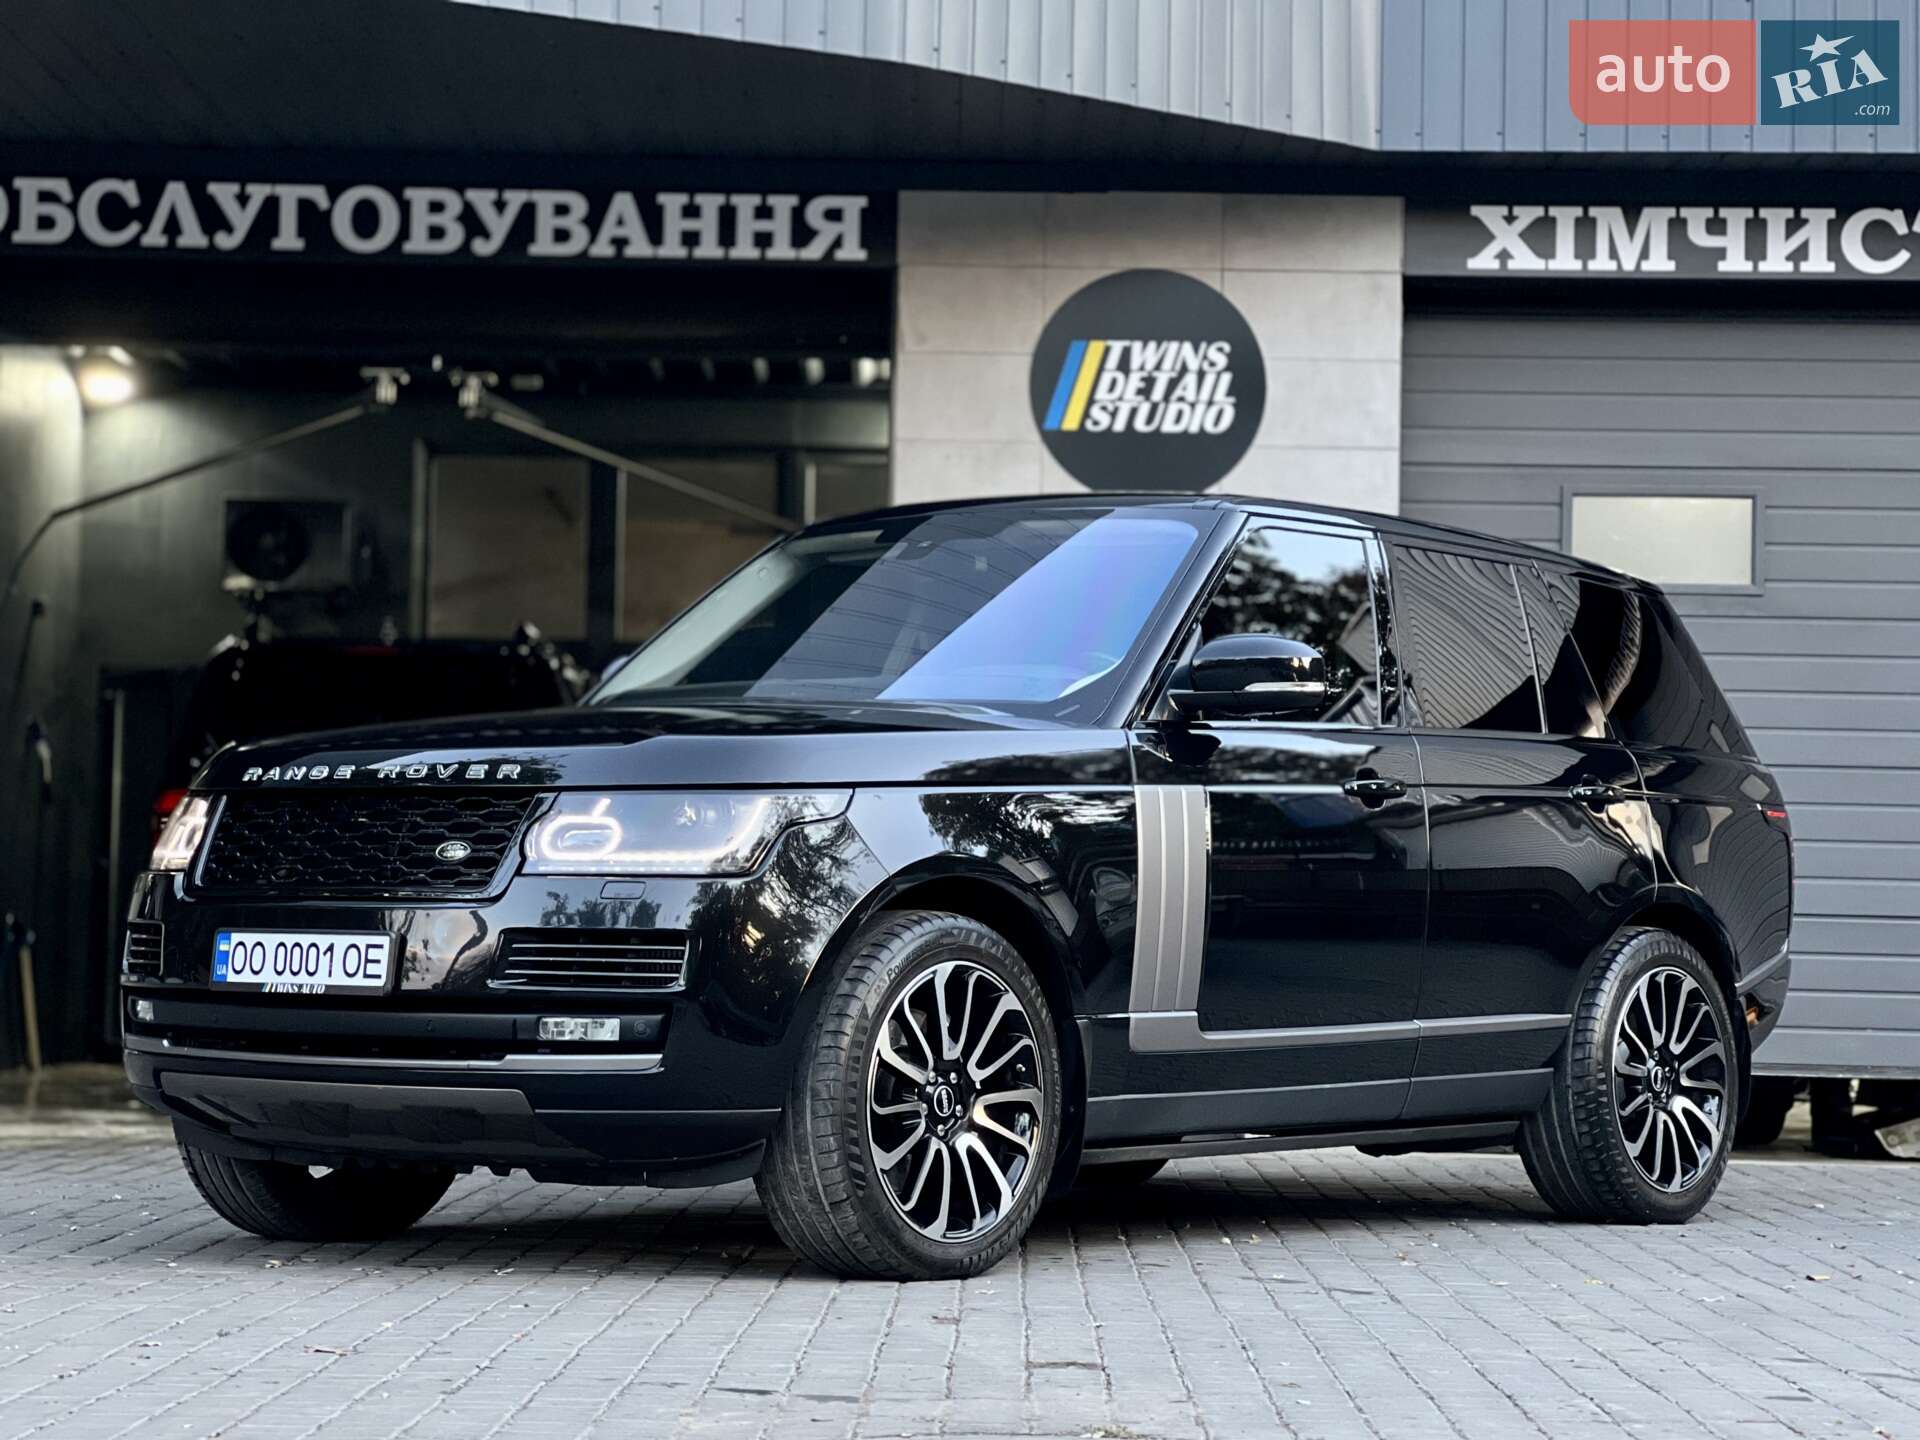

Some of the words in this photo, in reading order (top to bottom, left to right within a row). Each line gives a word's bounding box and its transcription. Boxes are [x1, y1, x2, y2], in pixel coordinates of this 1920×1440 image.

[0, 176, 869, 261] БСЛУГОВУВАННЯ
[1467, 205, 1920, 274] ХІМЧИС
[1104, 340, 1231, 373] TWINS
[1093, 371, 1236, 403] DETAIL
[1084, 402, 1236, 434] STUDIO
[242, 764, 355, 781] RANGE
[377, 763, 521, 780] ROVER
[216, 964, 227, 976] UA
[273, 941, 334, 978] 0001
